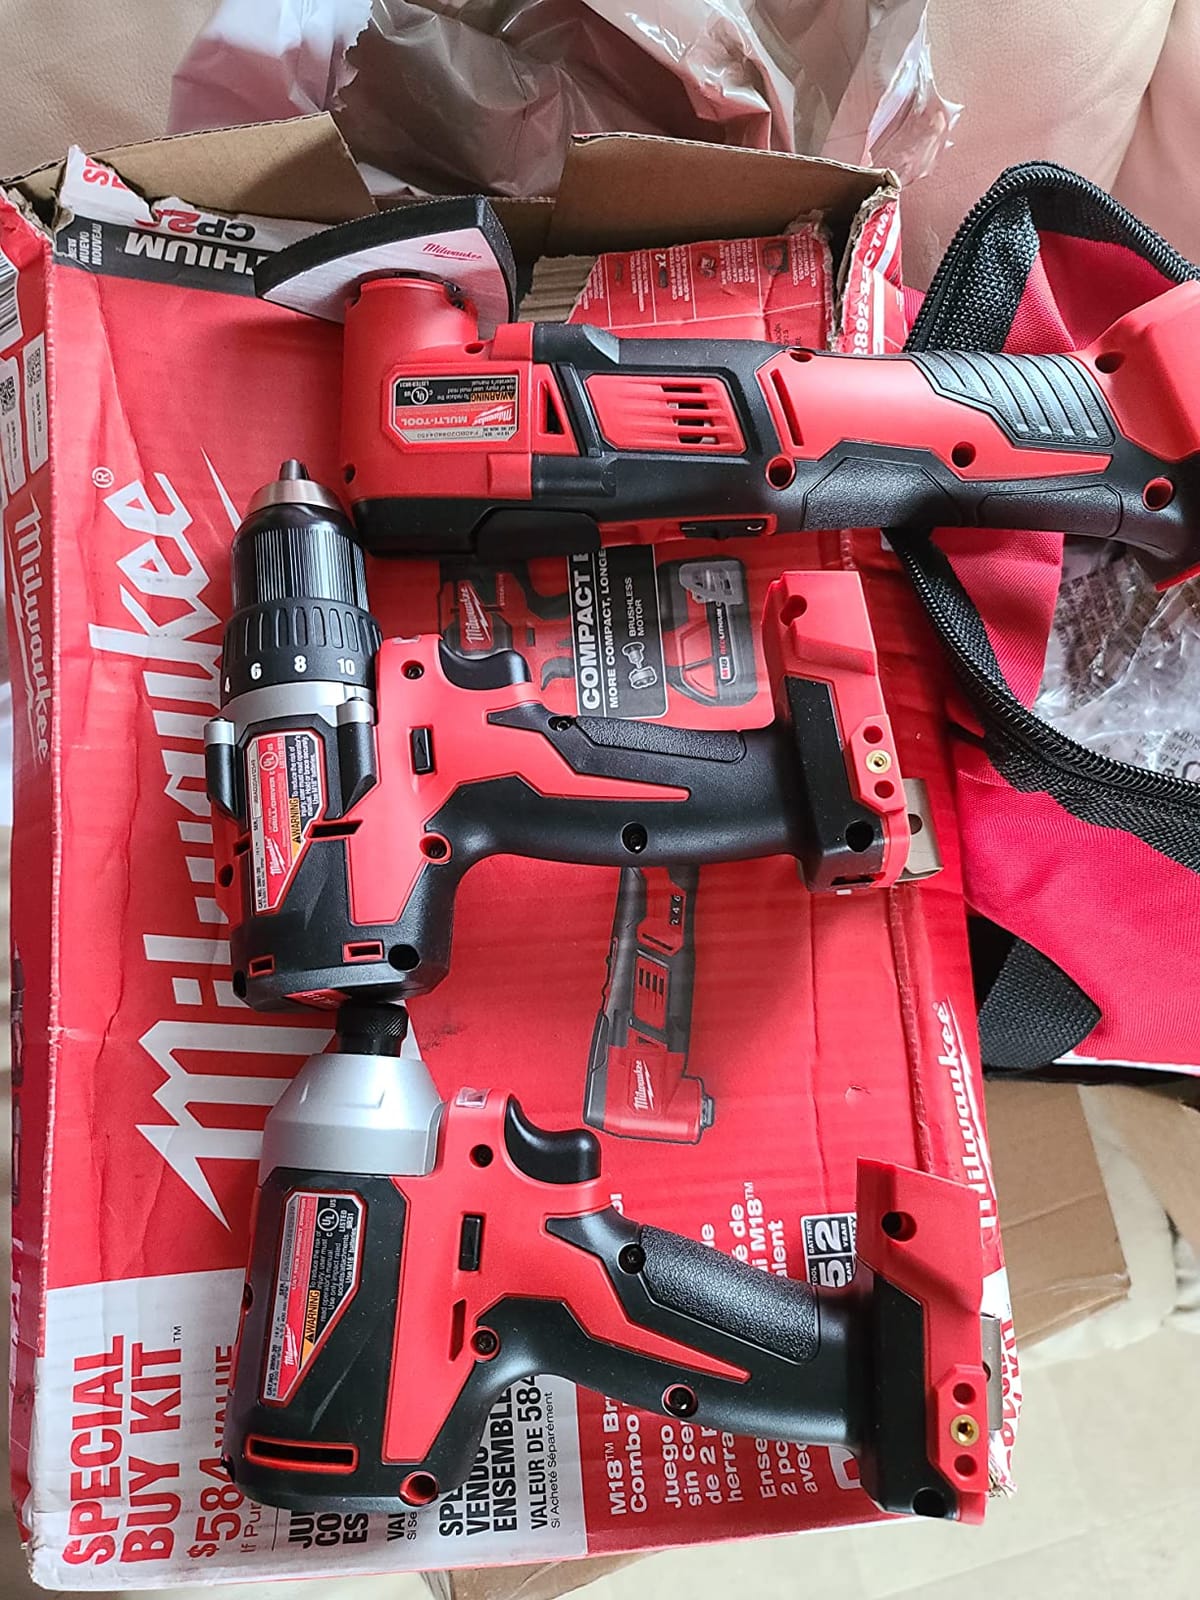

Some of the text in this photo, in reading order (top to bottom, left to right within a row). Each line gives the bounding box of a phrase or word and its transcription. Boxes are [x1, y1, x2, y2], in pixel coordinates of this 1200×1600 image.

[79, 232, 89, 263] NUEVO
[92, 223, 102, 265] NOUVEAU
[471, 392, 507, 401] WARNING
[460, 587, 484, 643] Milwaukee
[625, 577, 637, 637] BRUSHLESS
[635, 599, 645, 636] MOTOR
[15, 493, 51, 764] Milwaukee
[573, 570, 600, 709] COMPACT
[598, 548, 619, 708] MORE COMPACT, LONGE
[251, 663, 262, 680] 6
[294, 655, 307, 673] 8
[337, 658, 356, 675] 10
[290, 798, 300, 836] WARNING
[266, 836, 282, 876] Milwaukee
[633, 1060, 648, 1110] Milwaukee
[744, 1182, 766, 1251] M18™
[806, 1220, 814, 1254] BATTERY
[814, 1220, 842, 1251] 2
[840, 1222, 848, 1248] YEAR
[321, 1274, 331, 1305] operator's
[330, 1281, 340, 1296] only
[332, 1260, 341, 1281] impact
[305, 1291, 319, 1334] WARNING
[328, 1297, 336, 1310] Use
[285, 1324, 294, 1366] Milwaukee
[729, 1204, 778, 1498] Ense de
[62, 1335, 124, 1565] SPECIAL
[527, 1427, 544, 1453] DE
[544, 1392, 560, 1528] Si Acheté Séparément
[603, 1396, 627, 1515] M18™ Br
[700, 1446, 716, 1464] 2
[775, 1441, 796, 1474] pc
[625, 1414, 647, 1513] Combo
[661, 1425, 682, 1508] Juego
[680, 1420, 703, 1506] sin ce
[721, 1432, 744, 1502] herra
[528, 1459, 548, 1529] VALEUR
[706, 1474, 723, 1504] de
[781, 1482, 798, 1495] 2
[120, 1456, 181, 1563] BUY
[240, 1503, 260, 1553] If Pur
[315, 1513, 341, 1546] CO
[342, 1513, 369, 1544] ES
[407, 1529, 416, 1540] Si
